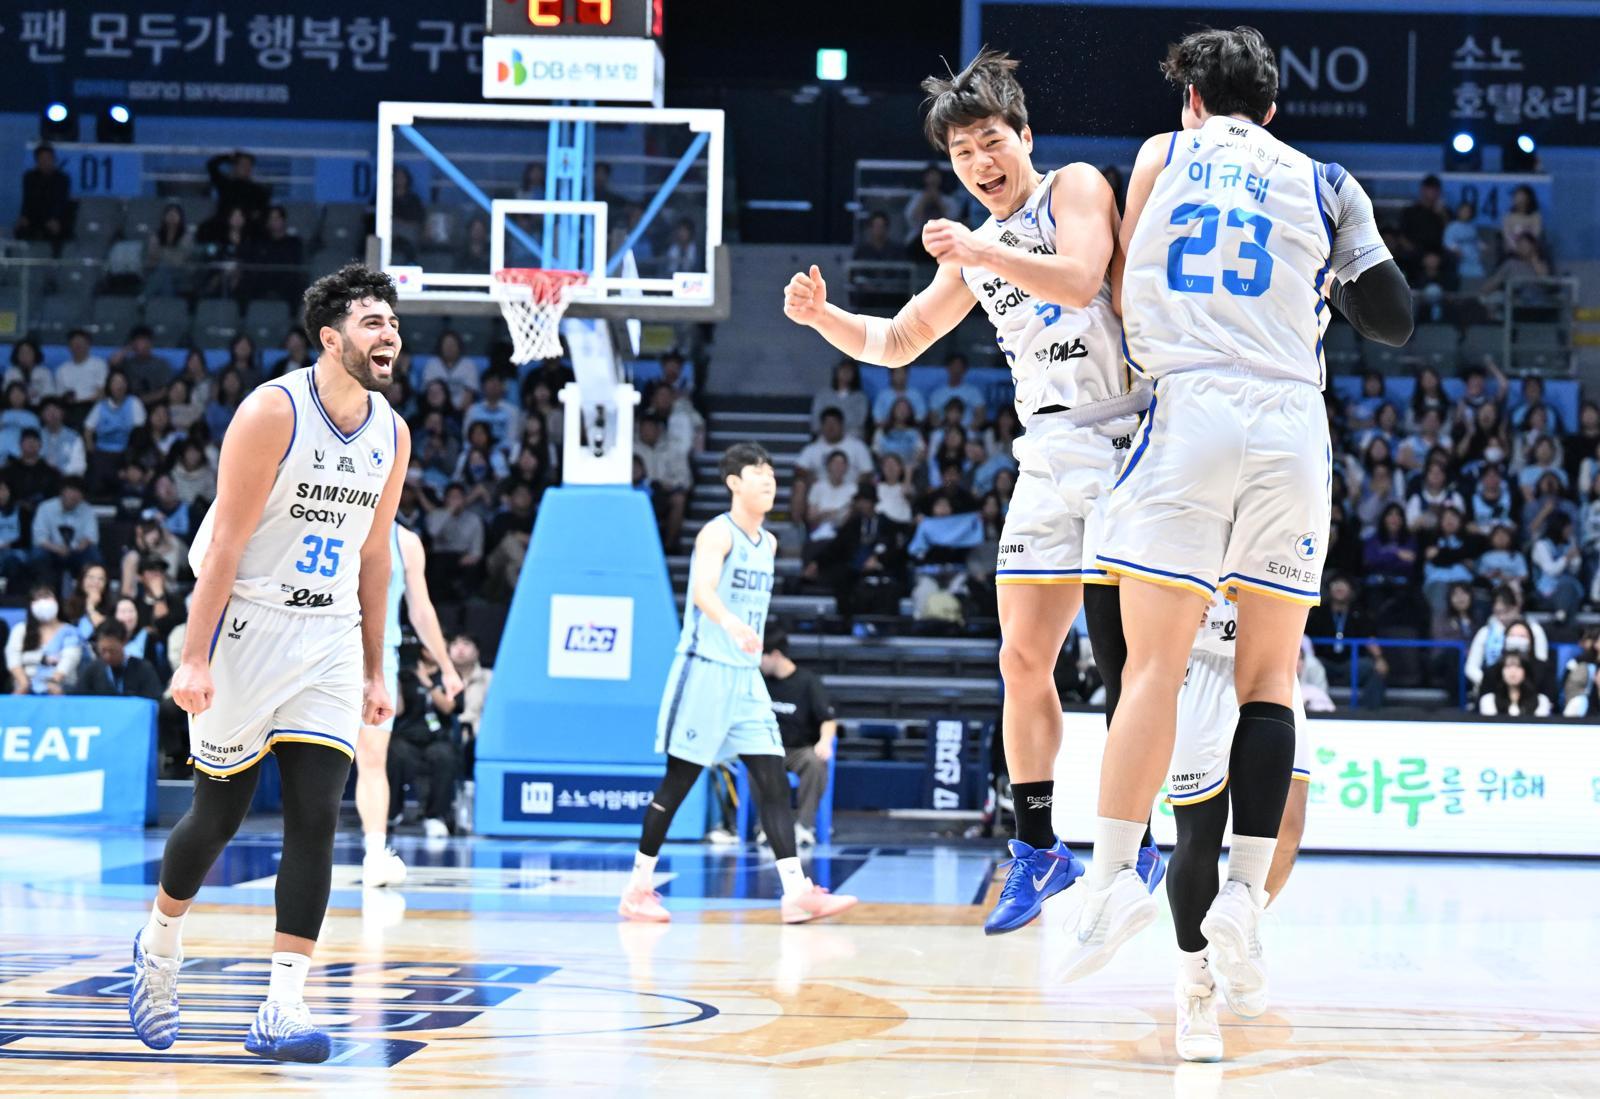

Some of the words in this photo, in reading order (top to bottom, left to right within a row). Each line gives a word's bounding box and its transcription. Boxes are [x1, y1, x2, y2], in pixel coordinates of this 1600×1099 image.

[20, 11, 65, 63] 팬
[85, 13, 231, 65] 모두가
[248, 15, 395, 71] 행복한
[1452, 34, 1524, 70] 소노
[1452, 81, 1600, 124] 호텔&리
[1188, 161, 1270, 204] 이규태
[1167, 202, 1275, 298] 23
[295, 534, 344, 578] 35
[998, 544, 1025, 554] SUNG
[1265, 560, 1302, 582] 도이치
[567, 626, 614, 651] KCC
[0, 726, 101, 762] EAT
[200, 749, 227, 764] Galaxy
[201, 739, 244, 754] SAMSUNG
[1172, 782, 1199, 791] Galaxy
[1338, 758, 1466, 828] 하루를
[1477, 769, 1545, 802] 위해
